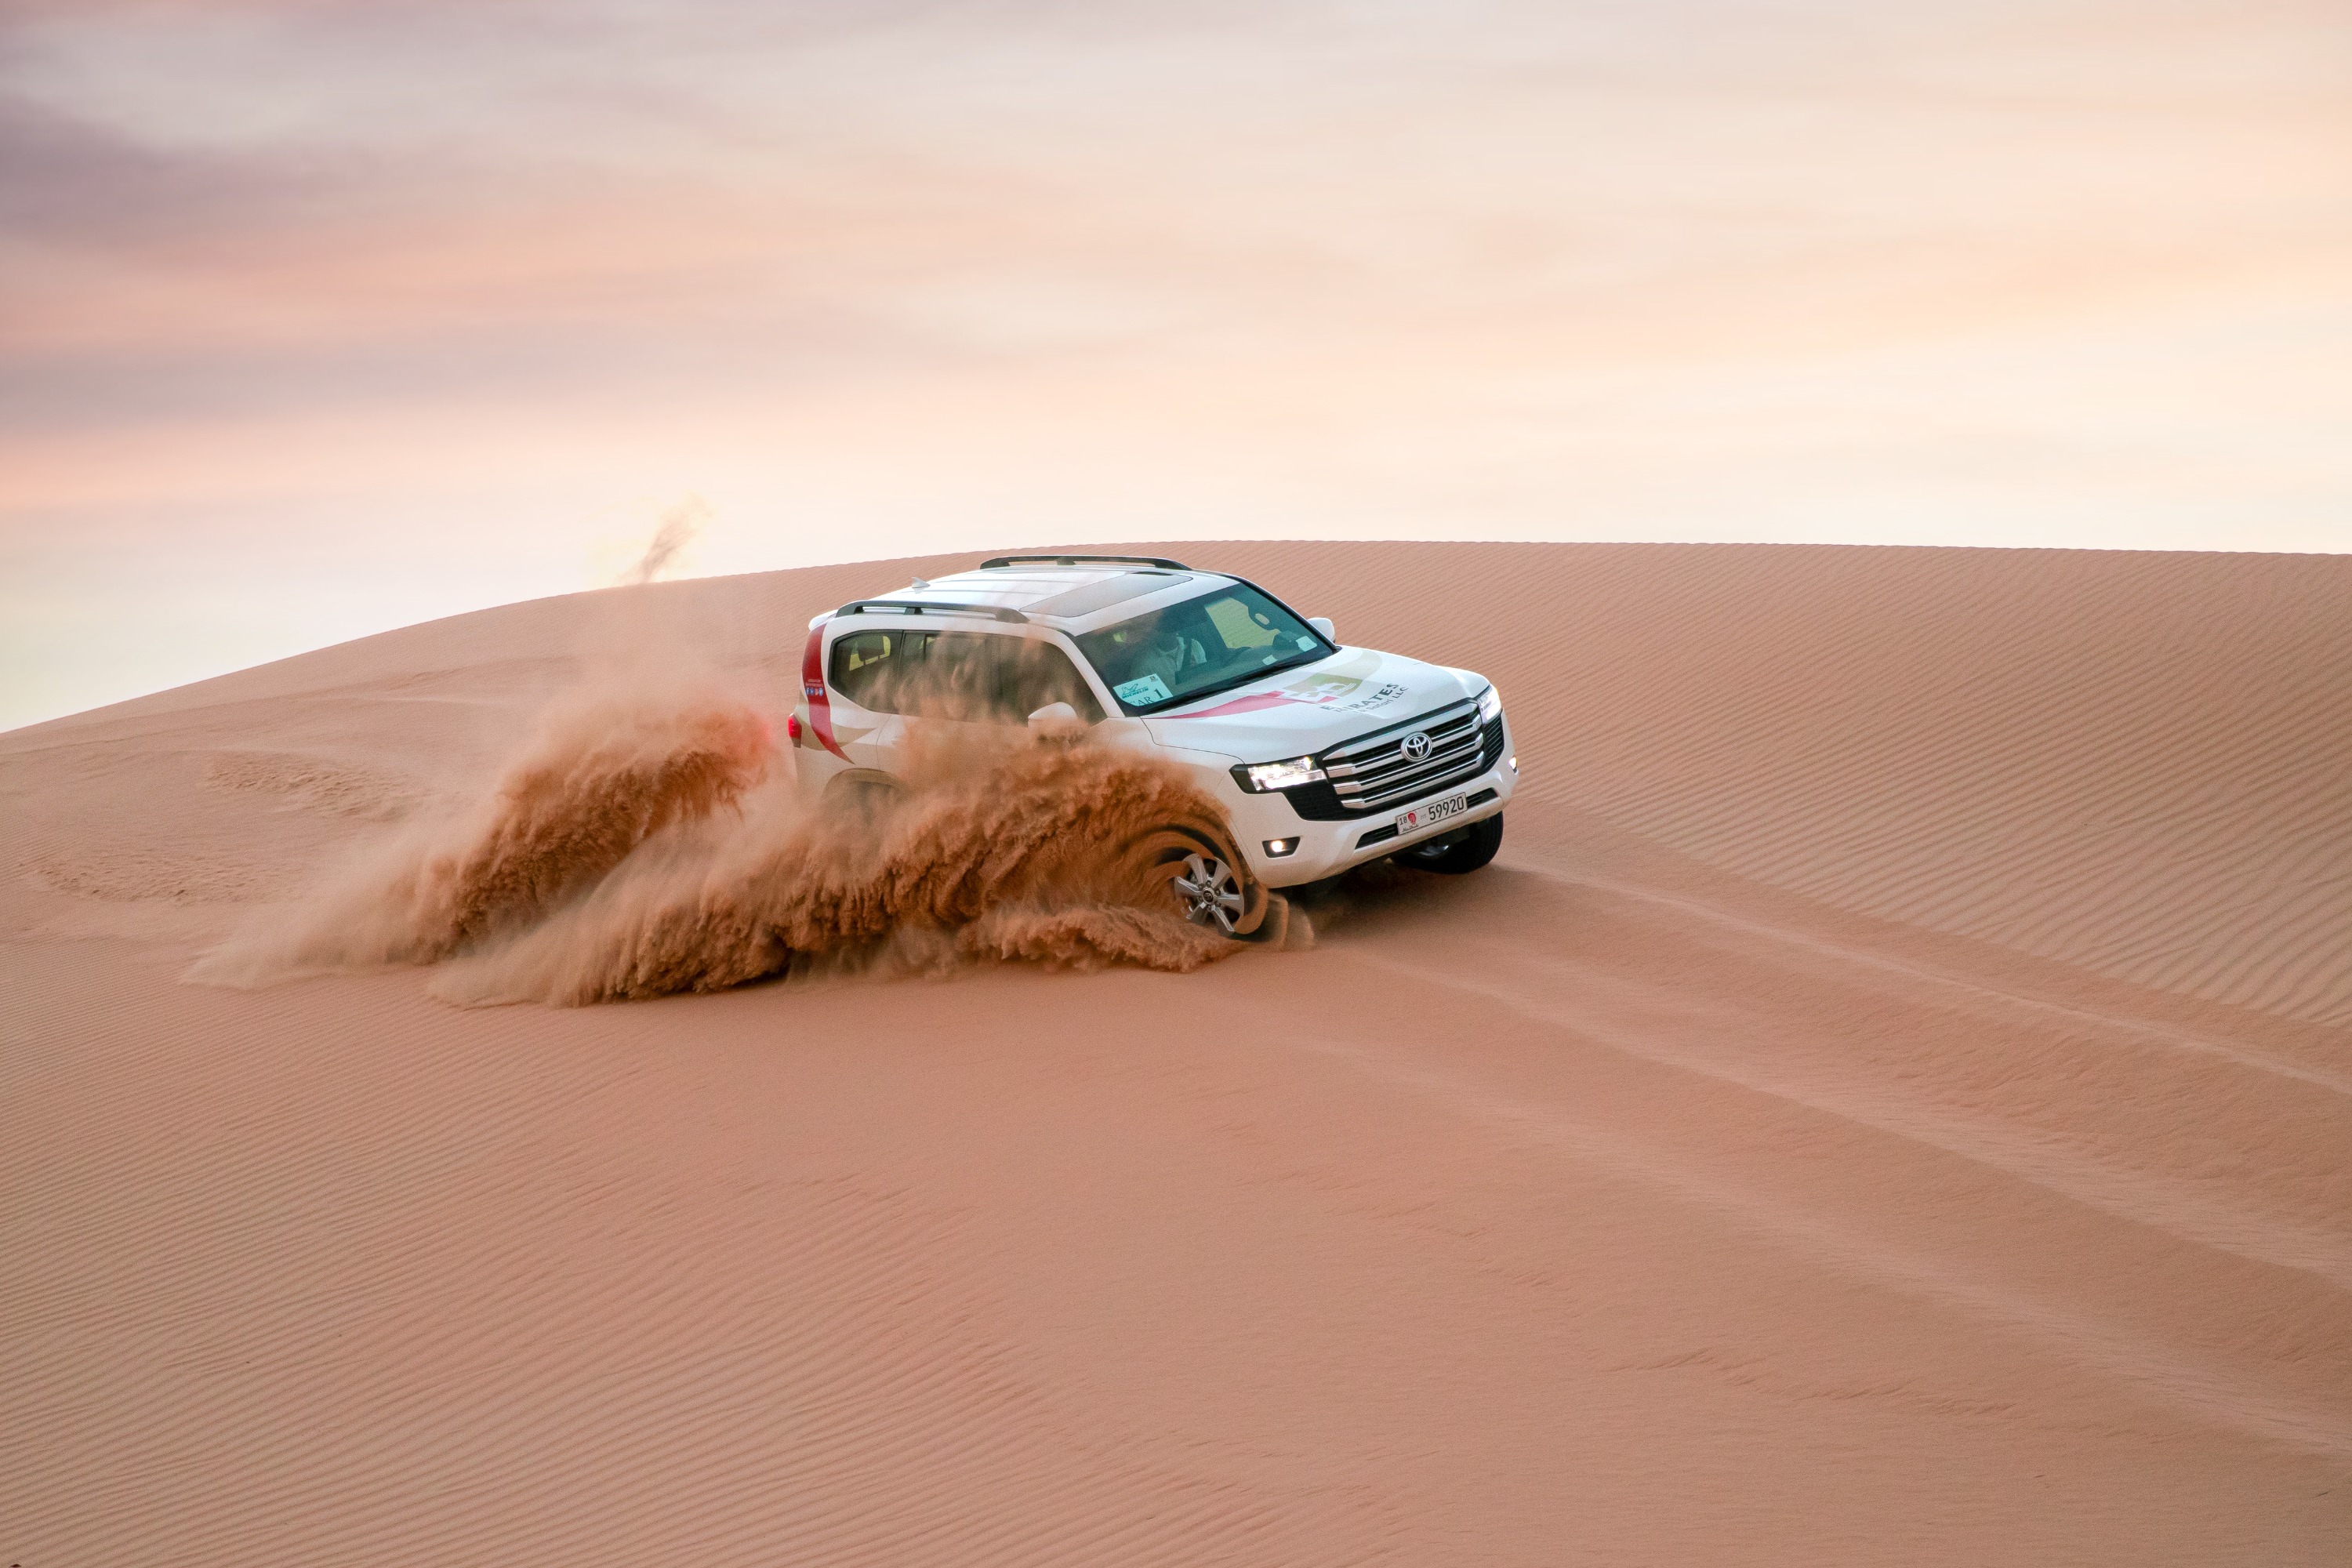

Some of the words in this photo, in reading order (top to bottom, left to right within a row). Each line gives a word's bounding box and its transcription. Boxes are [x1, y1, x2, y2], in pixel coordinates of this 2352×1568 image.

[1122, 688, 1149, 699] MICHELIN
[1153, 688, 1164, 699] 1
[1319, 683, 1399, 710] EIRATES
[1392, 687, 1409, 699] LLC
[1399, 816, 1407, 826] 18
[1428, 796, 1465, 821] 59920
